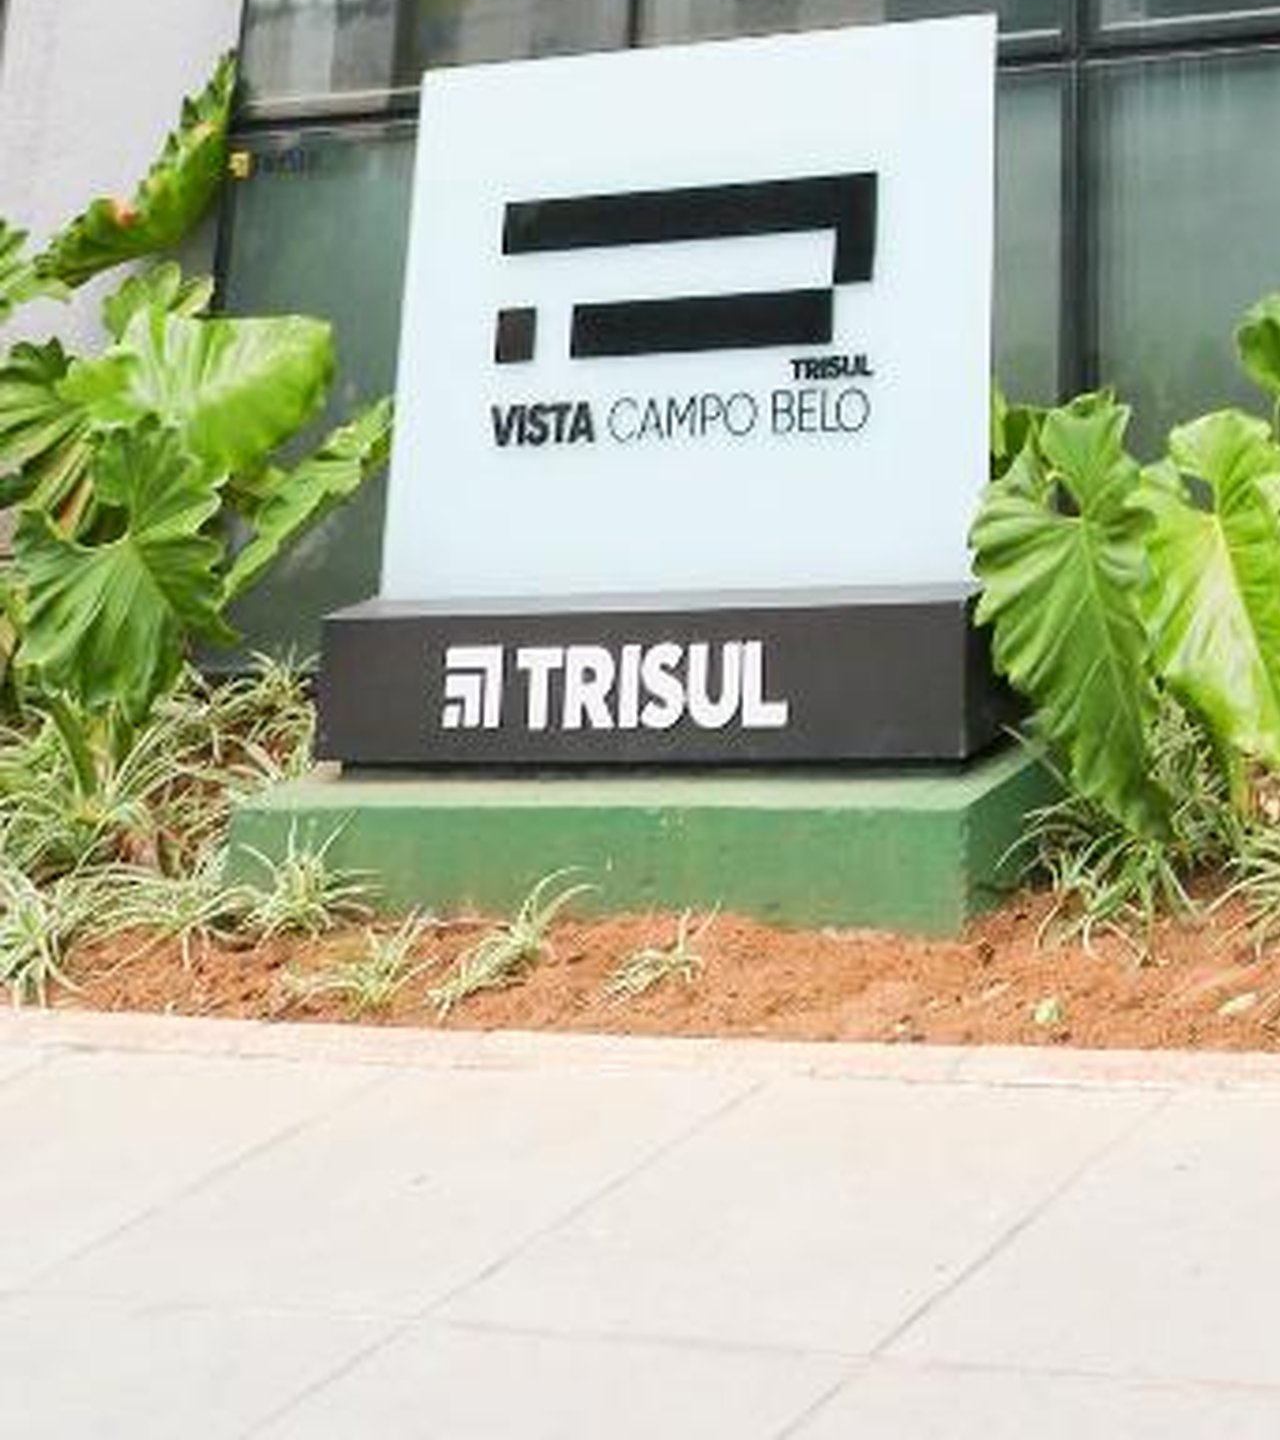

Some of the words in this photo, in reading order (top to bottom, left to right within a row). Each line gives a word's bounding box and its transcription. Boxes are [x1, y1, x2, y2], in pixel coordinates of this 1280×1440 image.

[789, 354, 873, 380] TRISUL
[491, 401, 595, 447] VISTA
[608, 392, 758, 443] CAMPO
[771, 386, 871, 435] BELO
[517, 641, 788, 730] TRISUL
